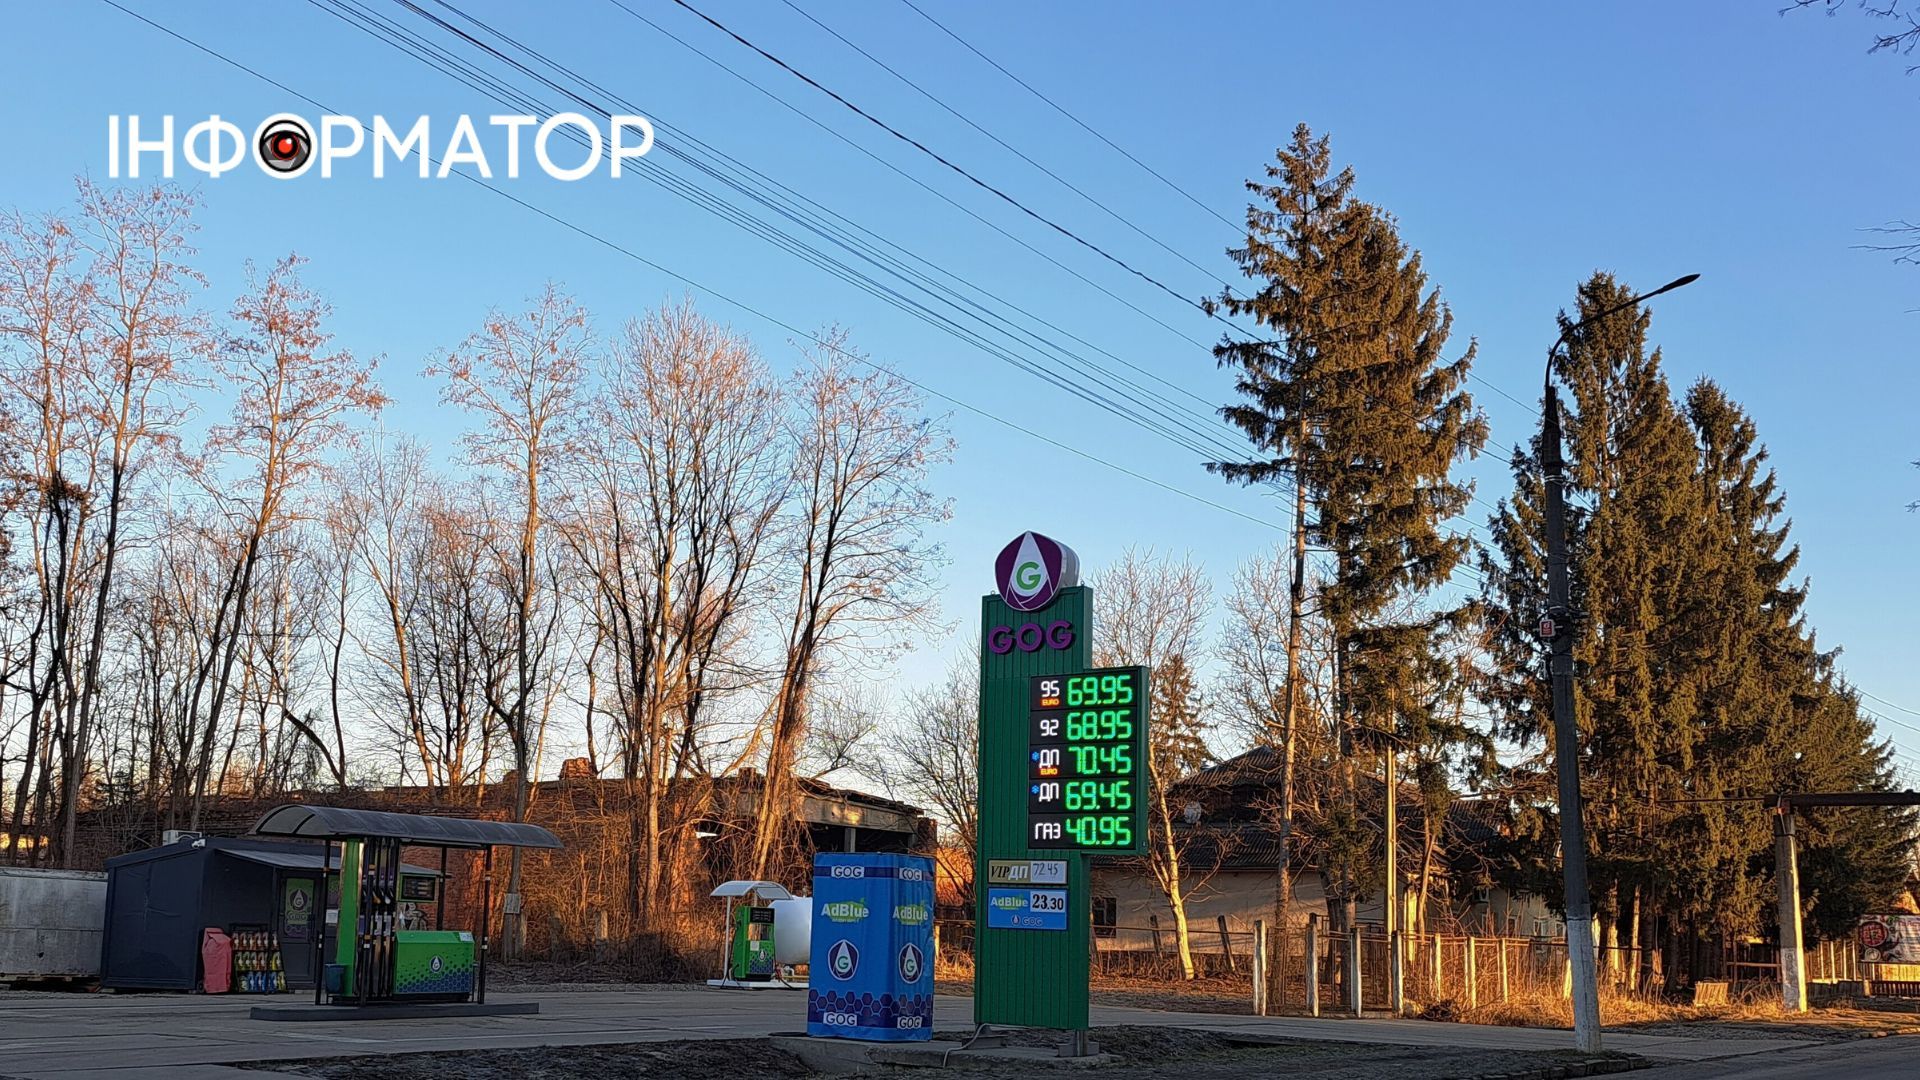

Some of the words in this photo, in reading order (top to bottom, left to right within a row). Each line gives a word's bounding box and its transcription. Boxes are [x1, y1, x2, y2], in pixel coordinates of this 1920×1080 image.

[1016, 561, 1042, 590] G
[988, 620, 1074, 654] GOG
[1040, 680, 1060, 698] 95
[1066, 674, 1133, 706] 69.95
[1041, 698, 1060, 706] EURO
[1040, 719, 1060, 737] 92
[1066, 709, 1132, 742] 68.95
[1038, 748, 1060, 769] ДП
[1067, 744, 1132, 775] 70.45
[1039, 767, 1058, 776] EURO
[1038, 782, 1060, 803] ДП
[1065, 780, 1132, 811] 69.45
[1034, 822, 1062, 840] ГАЗ
[1065, 815, 1132, 846] 40.95
[833, 866, 863, 878] GOG
[821, 902, 870, 919] AdBlue
[990, 896, 1029, 908] AdBlue
[1032, 894, 1064, 911] 23.30
[892, 904, 929, 921] AdBlue
[825, 1013, 856, 1026] GOG
[899, 1016, 920, 1028] GOG
